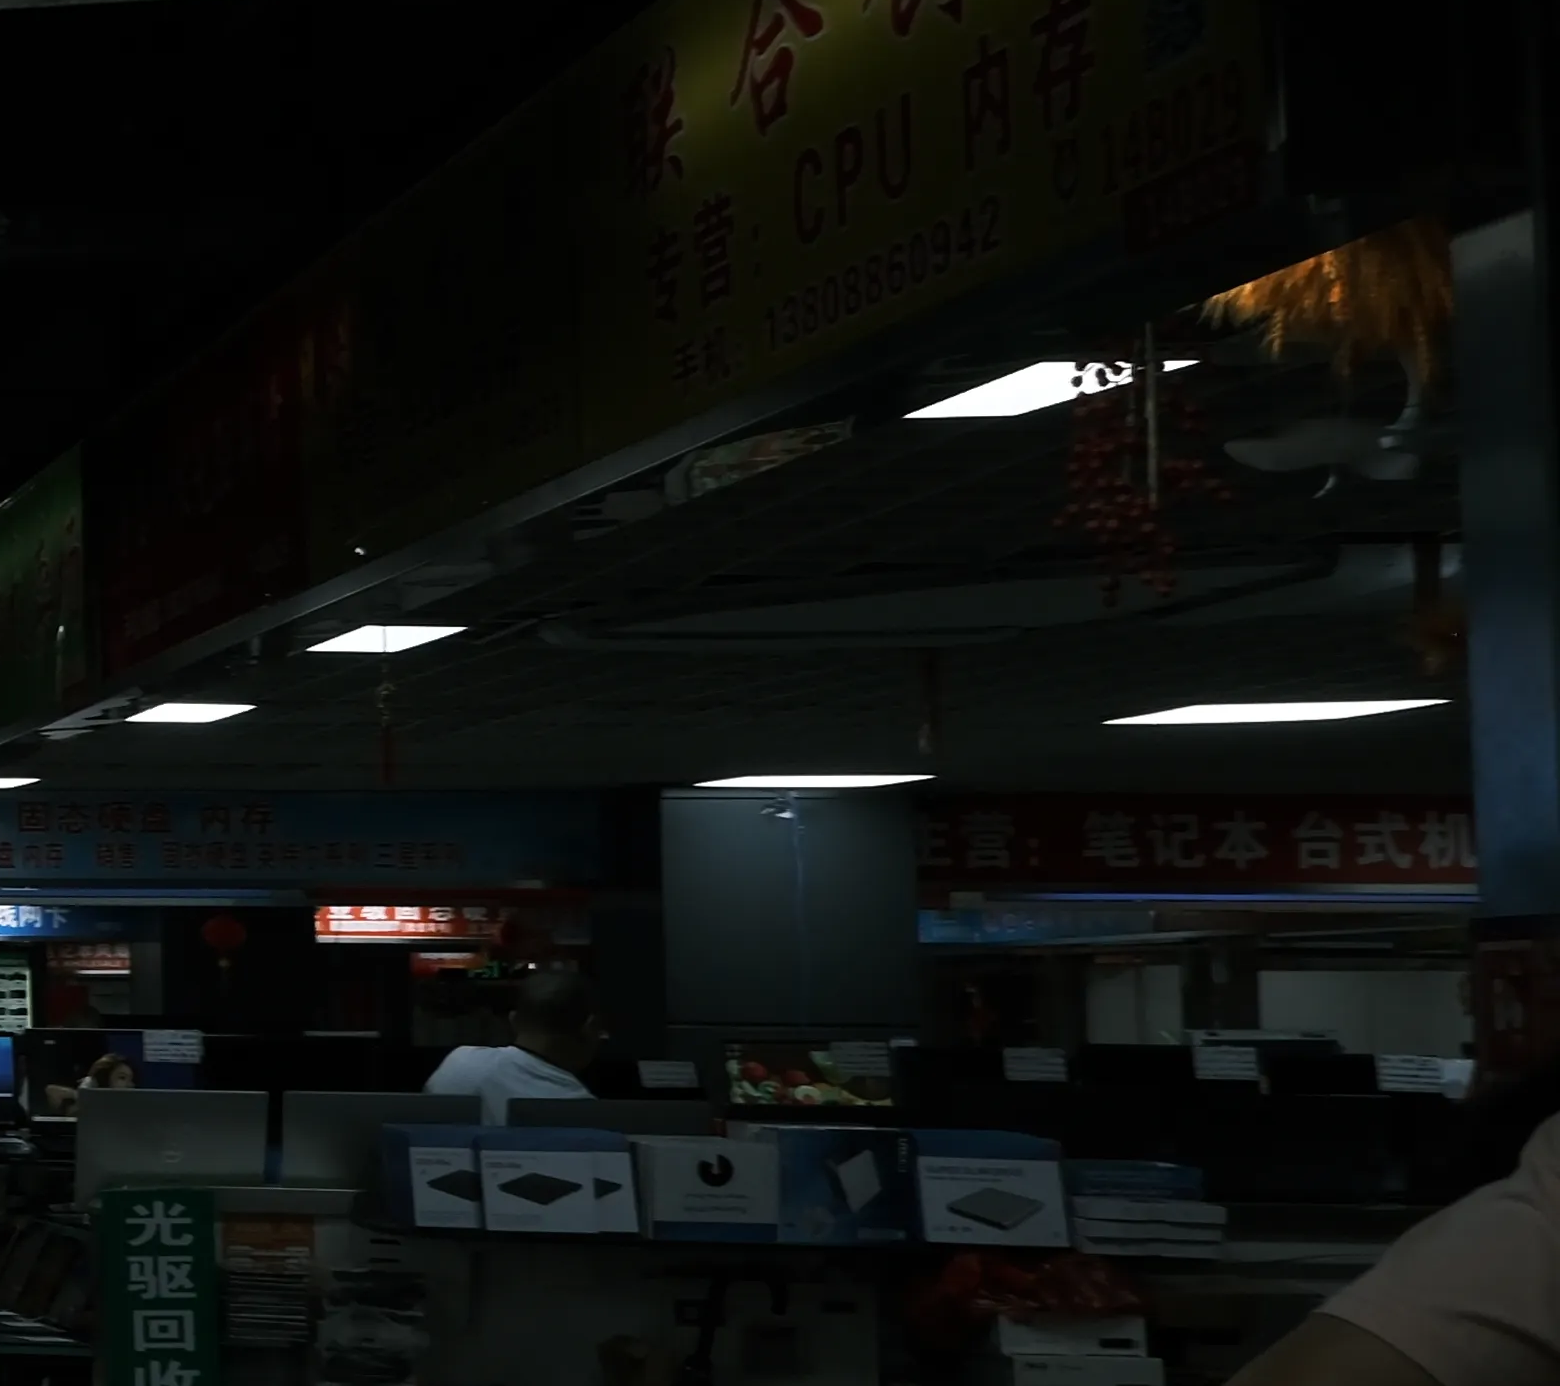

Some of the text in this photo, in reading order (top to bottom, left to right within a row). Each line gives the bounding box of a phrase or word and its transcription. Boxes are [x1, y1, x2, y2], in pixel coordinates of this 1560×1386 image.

[791, 92, 915, 248] CPU
[763, 192, 1003, 353] 13808860942
[16, 800, 174, 835] 固态硬盘
[199, 799, 276, 835] 内存
[1082, 808, 1269, 870] 笔记本
[1291, 809, 1479, 871] 台式机
